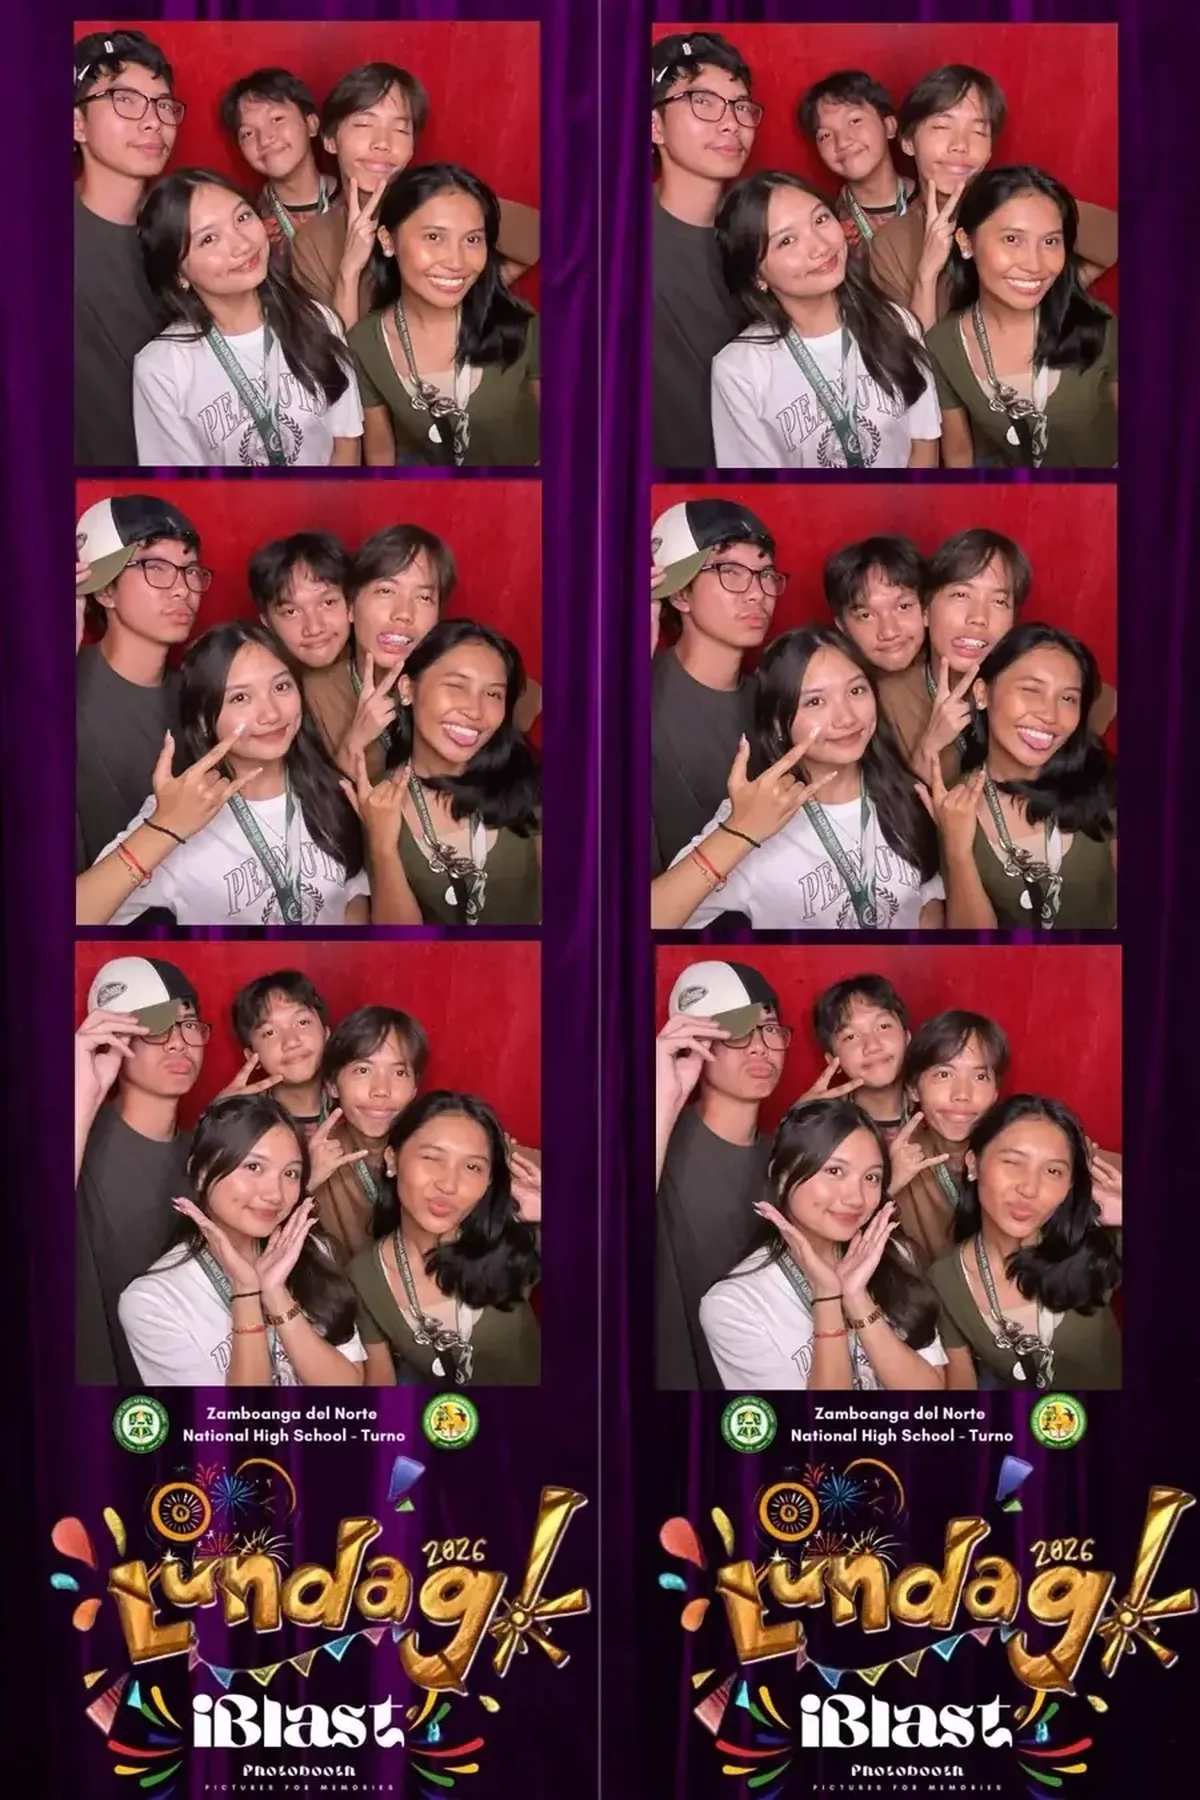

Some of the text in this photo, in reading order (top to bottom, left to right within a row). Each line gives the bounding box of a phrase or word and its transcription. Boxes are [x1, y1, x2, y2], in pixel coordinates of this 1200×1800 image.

[206, 1405, 377, 1424] Zamboanga del Norte
[814, 1405, 985, 1424] Zamboanga del Norte
[183, 1427, 249, 1442] National
[253, 1427, 289, 1446] High
[293, 1427, 347, 1442] School
[360, 1428, 406, 1442] Turno
[791, 1427, 857, 1442] National
[861, 1427, 897, 1446] High
[901, 1427, 955, 1442] School
[968, 1428, 1014, 1442] Turno
[421, 1536, 487, 1567] 2026
[1029, 1536, 1095, 1567] 2026
[192, 1693, 405, 1748] iBlast
[800, 1693, 1013, 1748] iBlast
[243, 1764, 356, 1777] Photobooth
[851, 1764, 964, 1777] Photobooth
